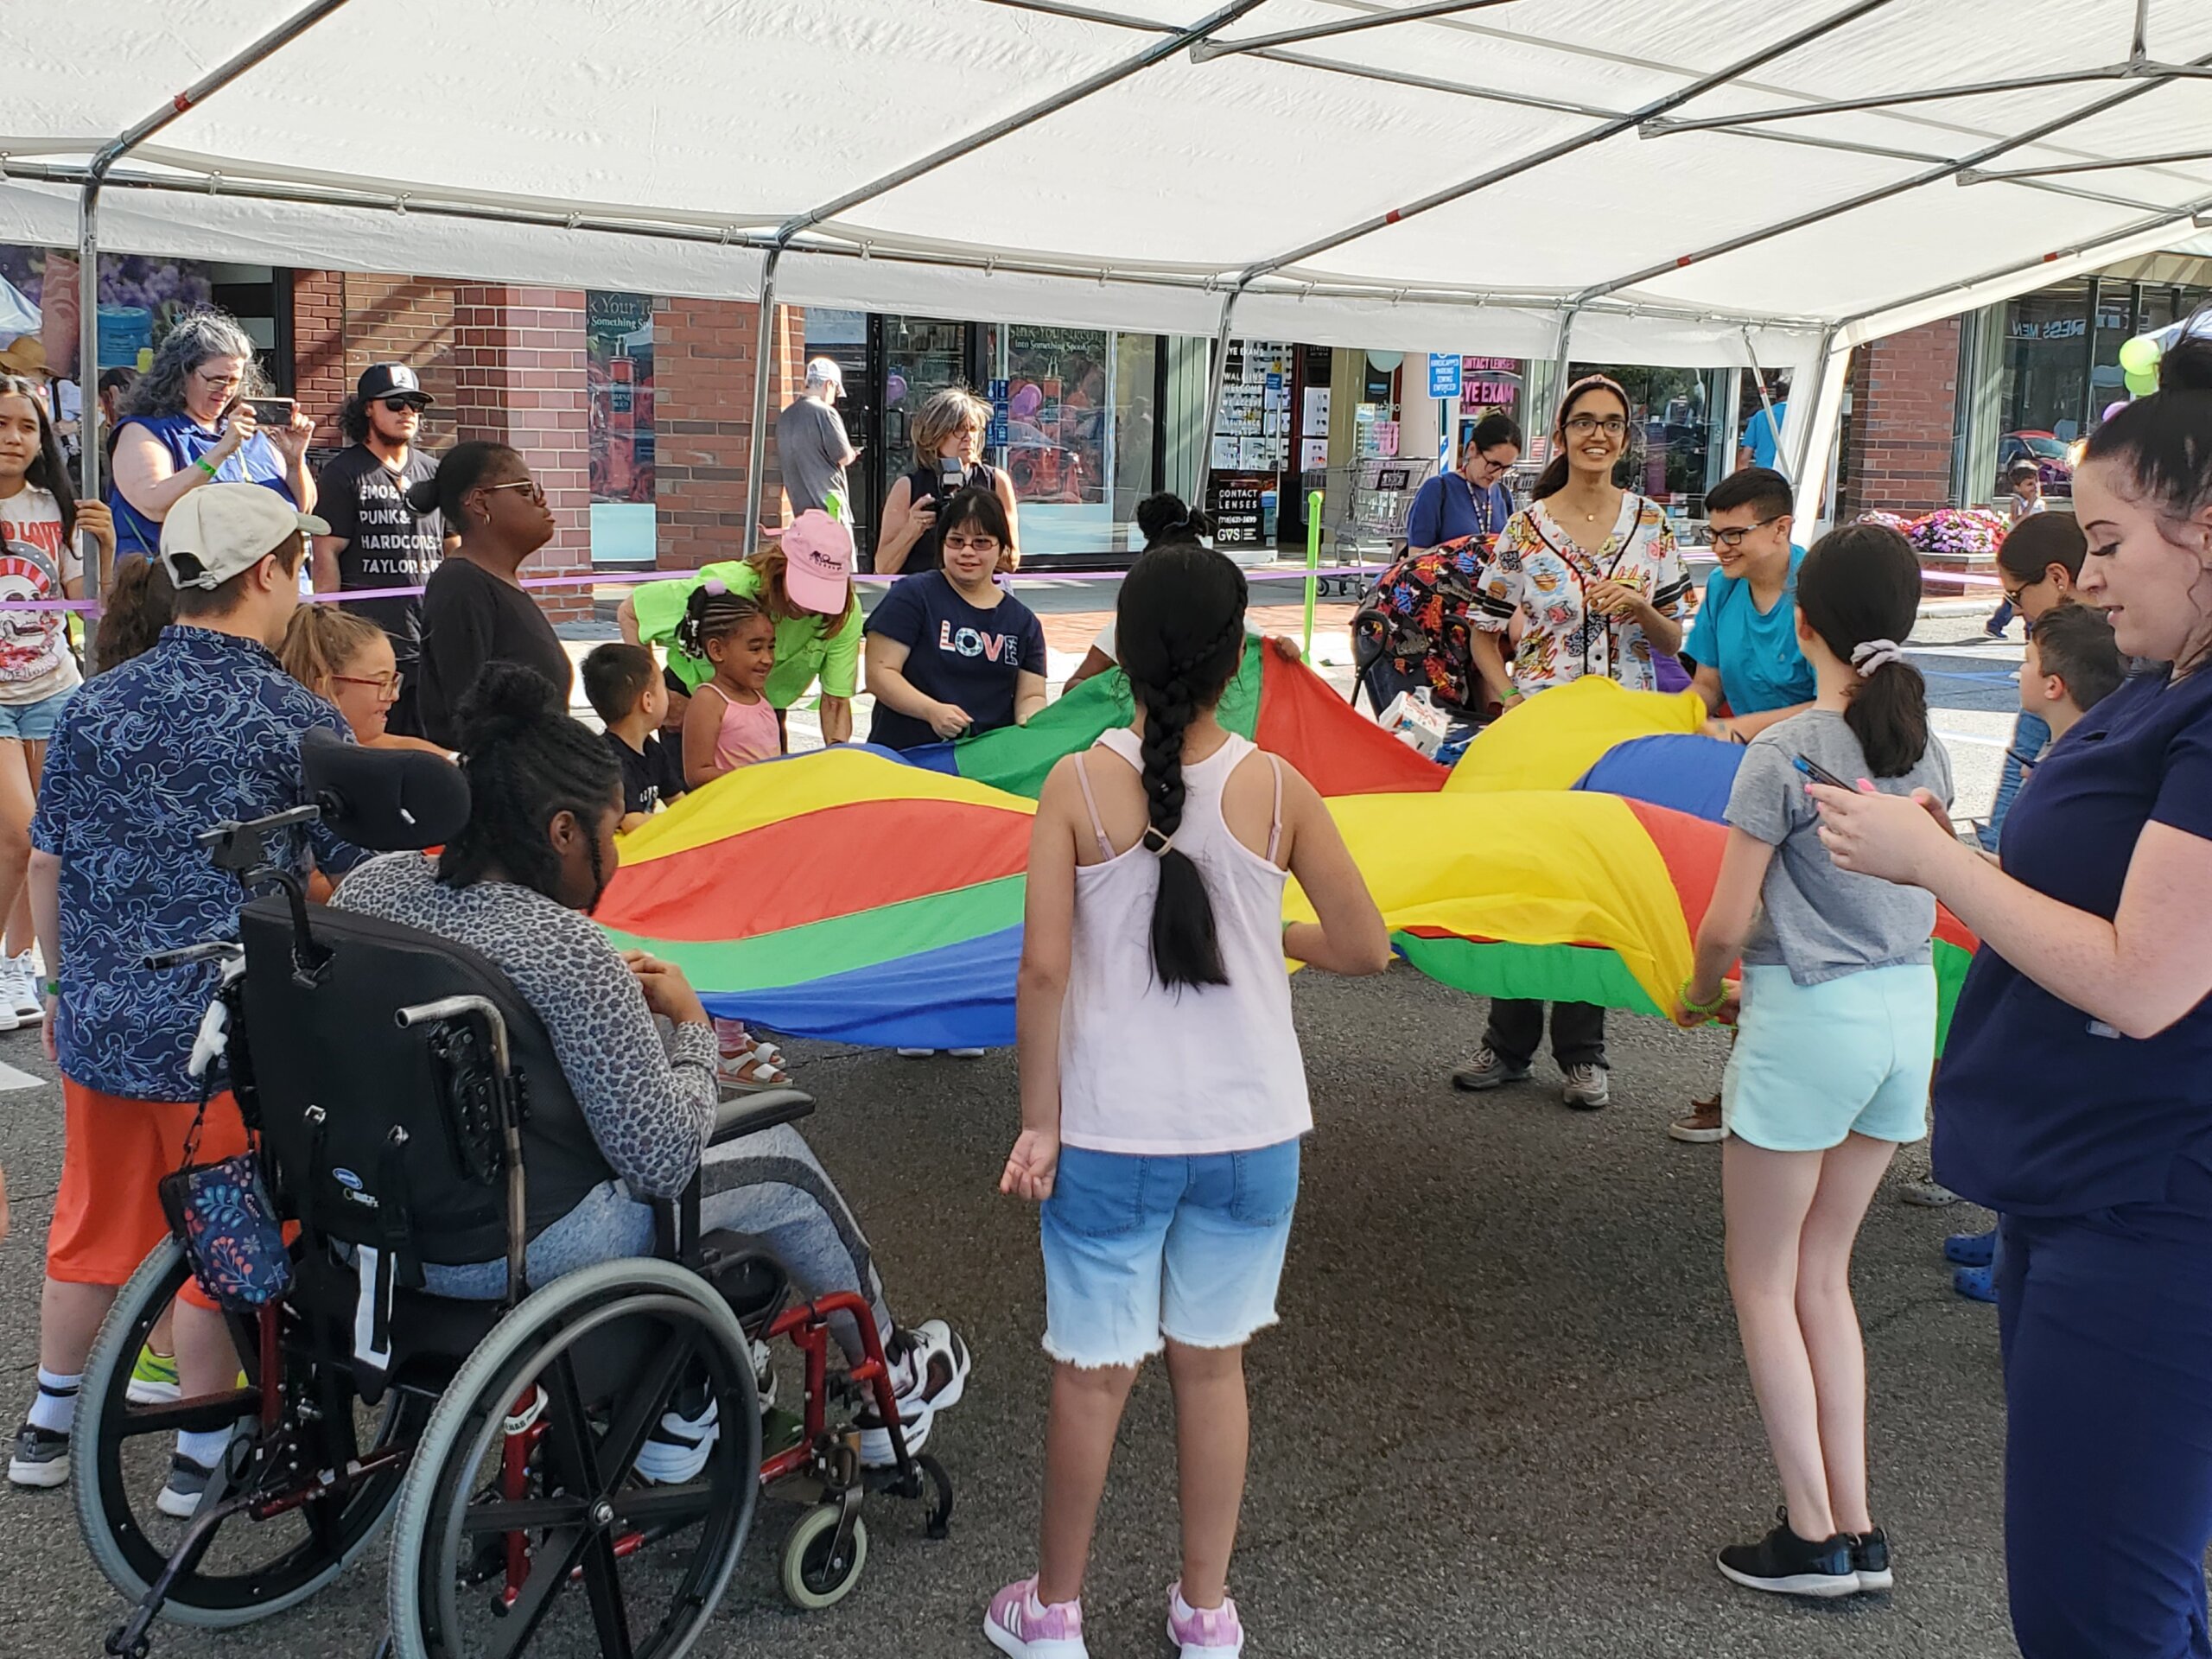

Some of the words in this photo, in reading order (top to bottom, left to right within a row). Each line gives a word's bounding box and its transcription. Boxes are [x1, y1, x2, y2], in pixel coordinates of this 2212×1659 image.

[601, 293, 637, 315] Your
[591, 315, 637, 331] Something
[1030, 340, 1065, 353] Something
[1227, 347, 1237, 356] YE
[1491, 358, 1516, 371] LENSES
[1460, 382, 1480, 403] YE
[1481, 382, 1514, 404] EXAM
[359, 485, 400, 500] EMO&
[1218, 489, 1258, 499] CONTACT
[1218, 500, 1257, 510] LENSES
[359, 510, 411, 525] PUNK&
[363, 558, 419, 575] TAYLOR
[939, 620, 1019, 666] LOVE
